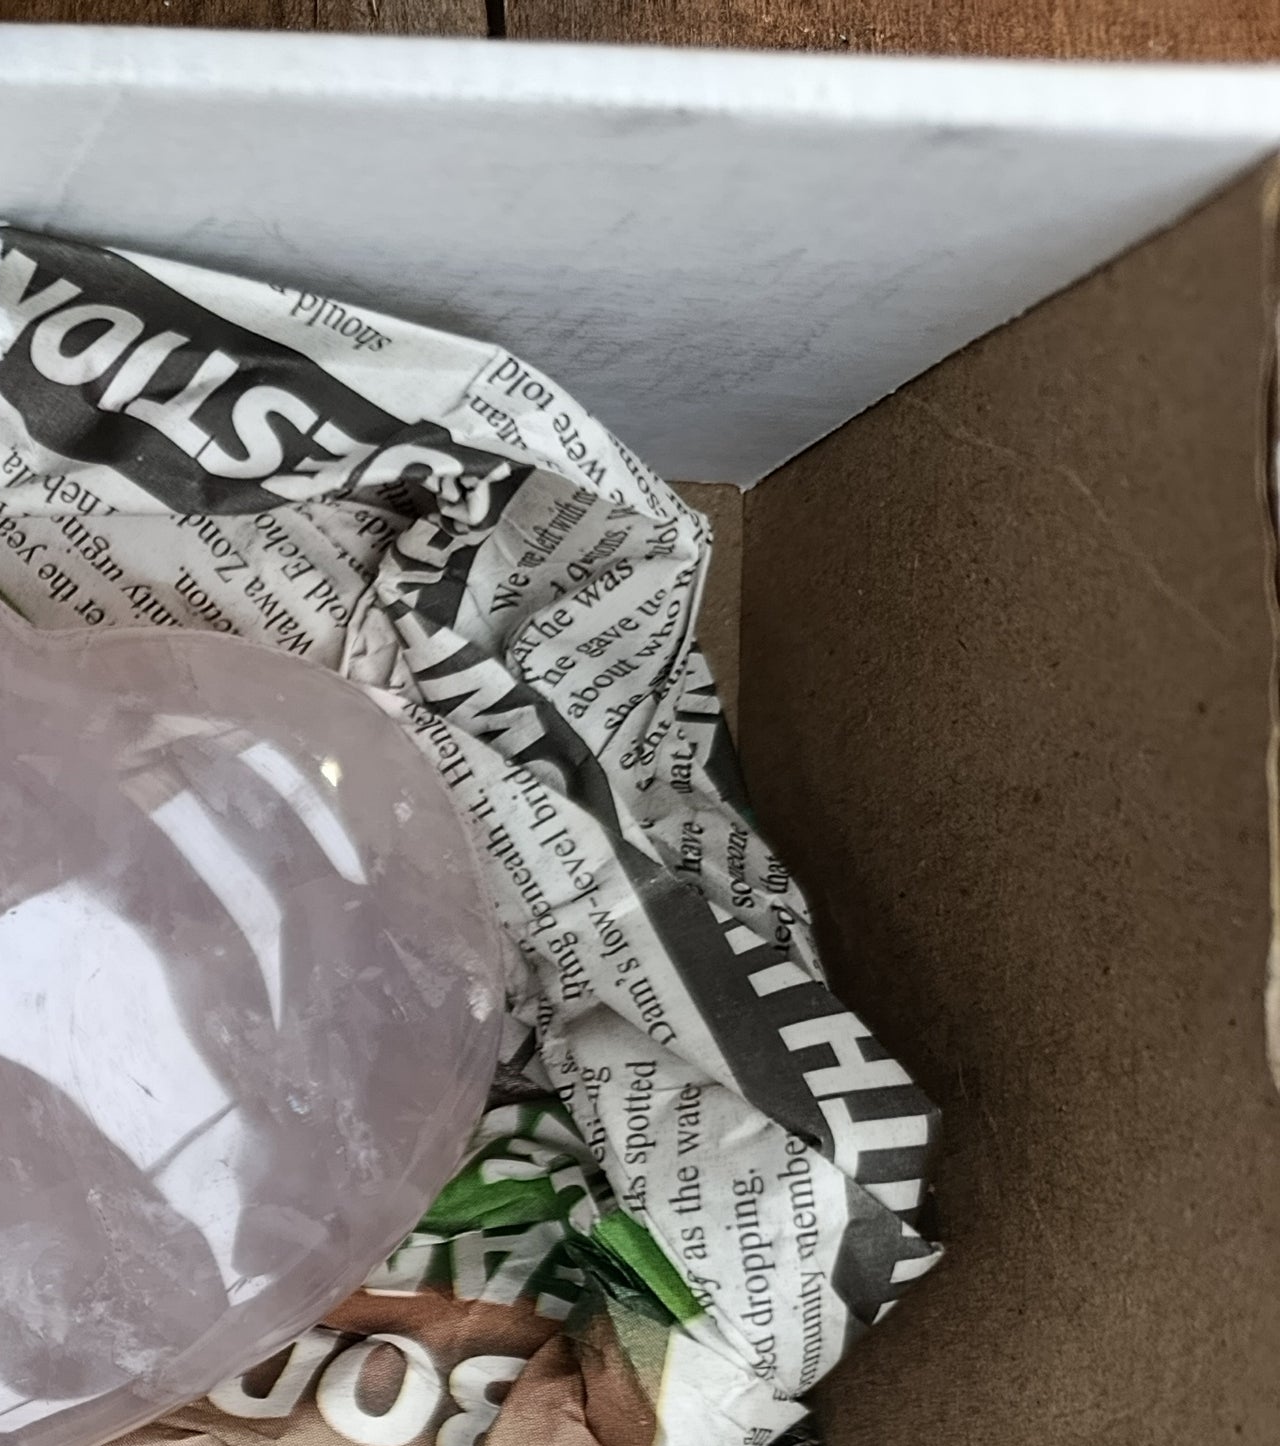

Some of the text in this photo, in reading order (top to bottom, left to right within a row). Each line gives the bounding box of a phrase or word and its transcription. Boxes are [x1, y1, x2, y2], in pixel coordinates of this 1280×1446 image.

[487, 356, 556, 419] told
[552, 411, 609, 490] were
[36, 559, 79, 601] the
[253, 510, 316, 584] Echo
[573, 556, 637, 611] was
[243, 576, 315, 656] Walwa
[489, 571, 532, 615] We
[565, 658, 639, 722] about
[634, 598, 683, 662] who
[575, 613, 641, 660] gave
[603, 690, 648, 735] she
[483, 811, 559, 930] beneath
[552, 836, 632, 971] low-level
[615, 971, 678, 1050] Dam's
[621, 1056, 658, 1176] spotted
[668, 1162, 704, 1222] the
[682, 1226, 710, 1262] as
[725, 1165, 779, 1329] dropping.
